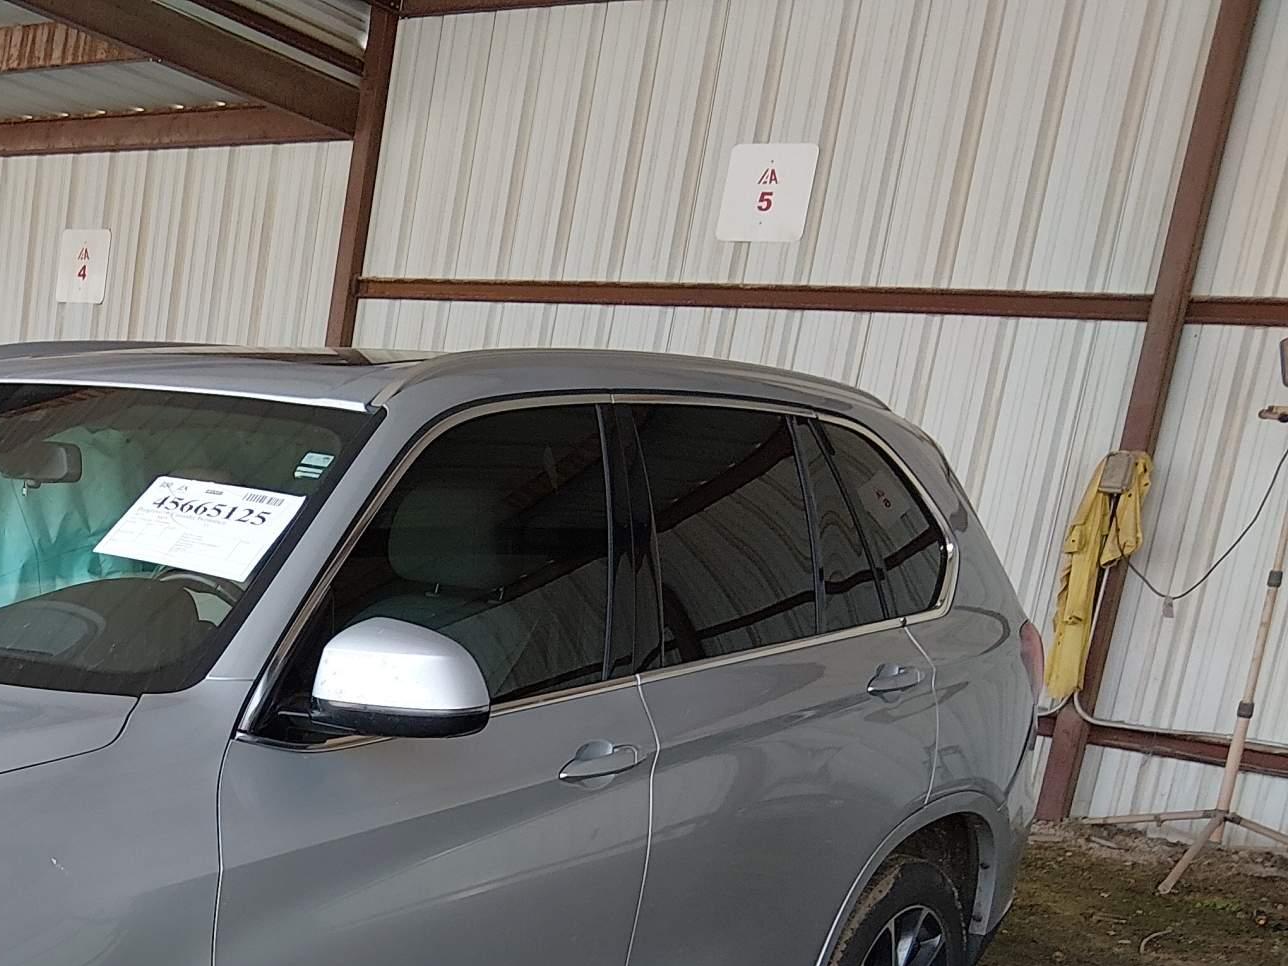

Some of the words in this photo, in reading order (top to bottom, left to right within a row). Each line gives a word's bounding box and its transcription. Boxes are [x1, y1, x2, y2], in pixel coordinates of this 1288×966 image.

[757, 191, 773, 211] 5
[77, 264, 87, 280] 4
[153, 495, 272, 526] 45665125
